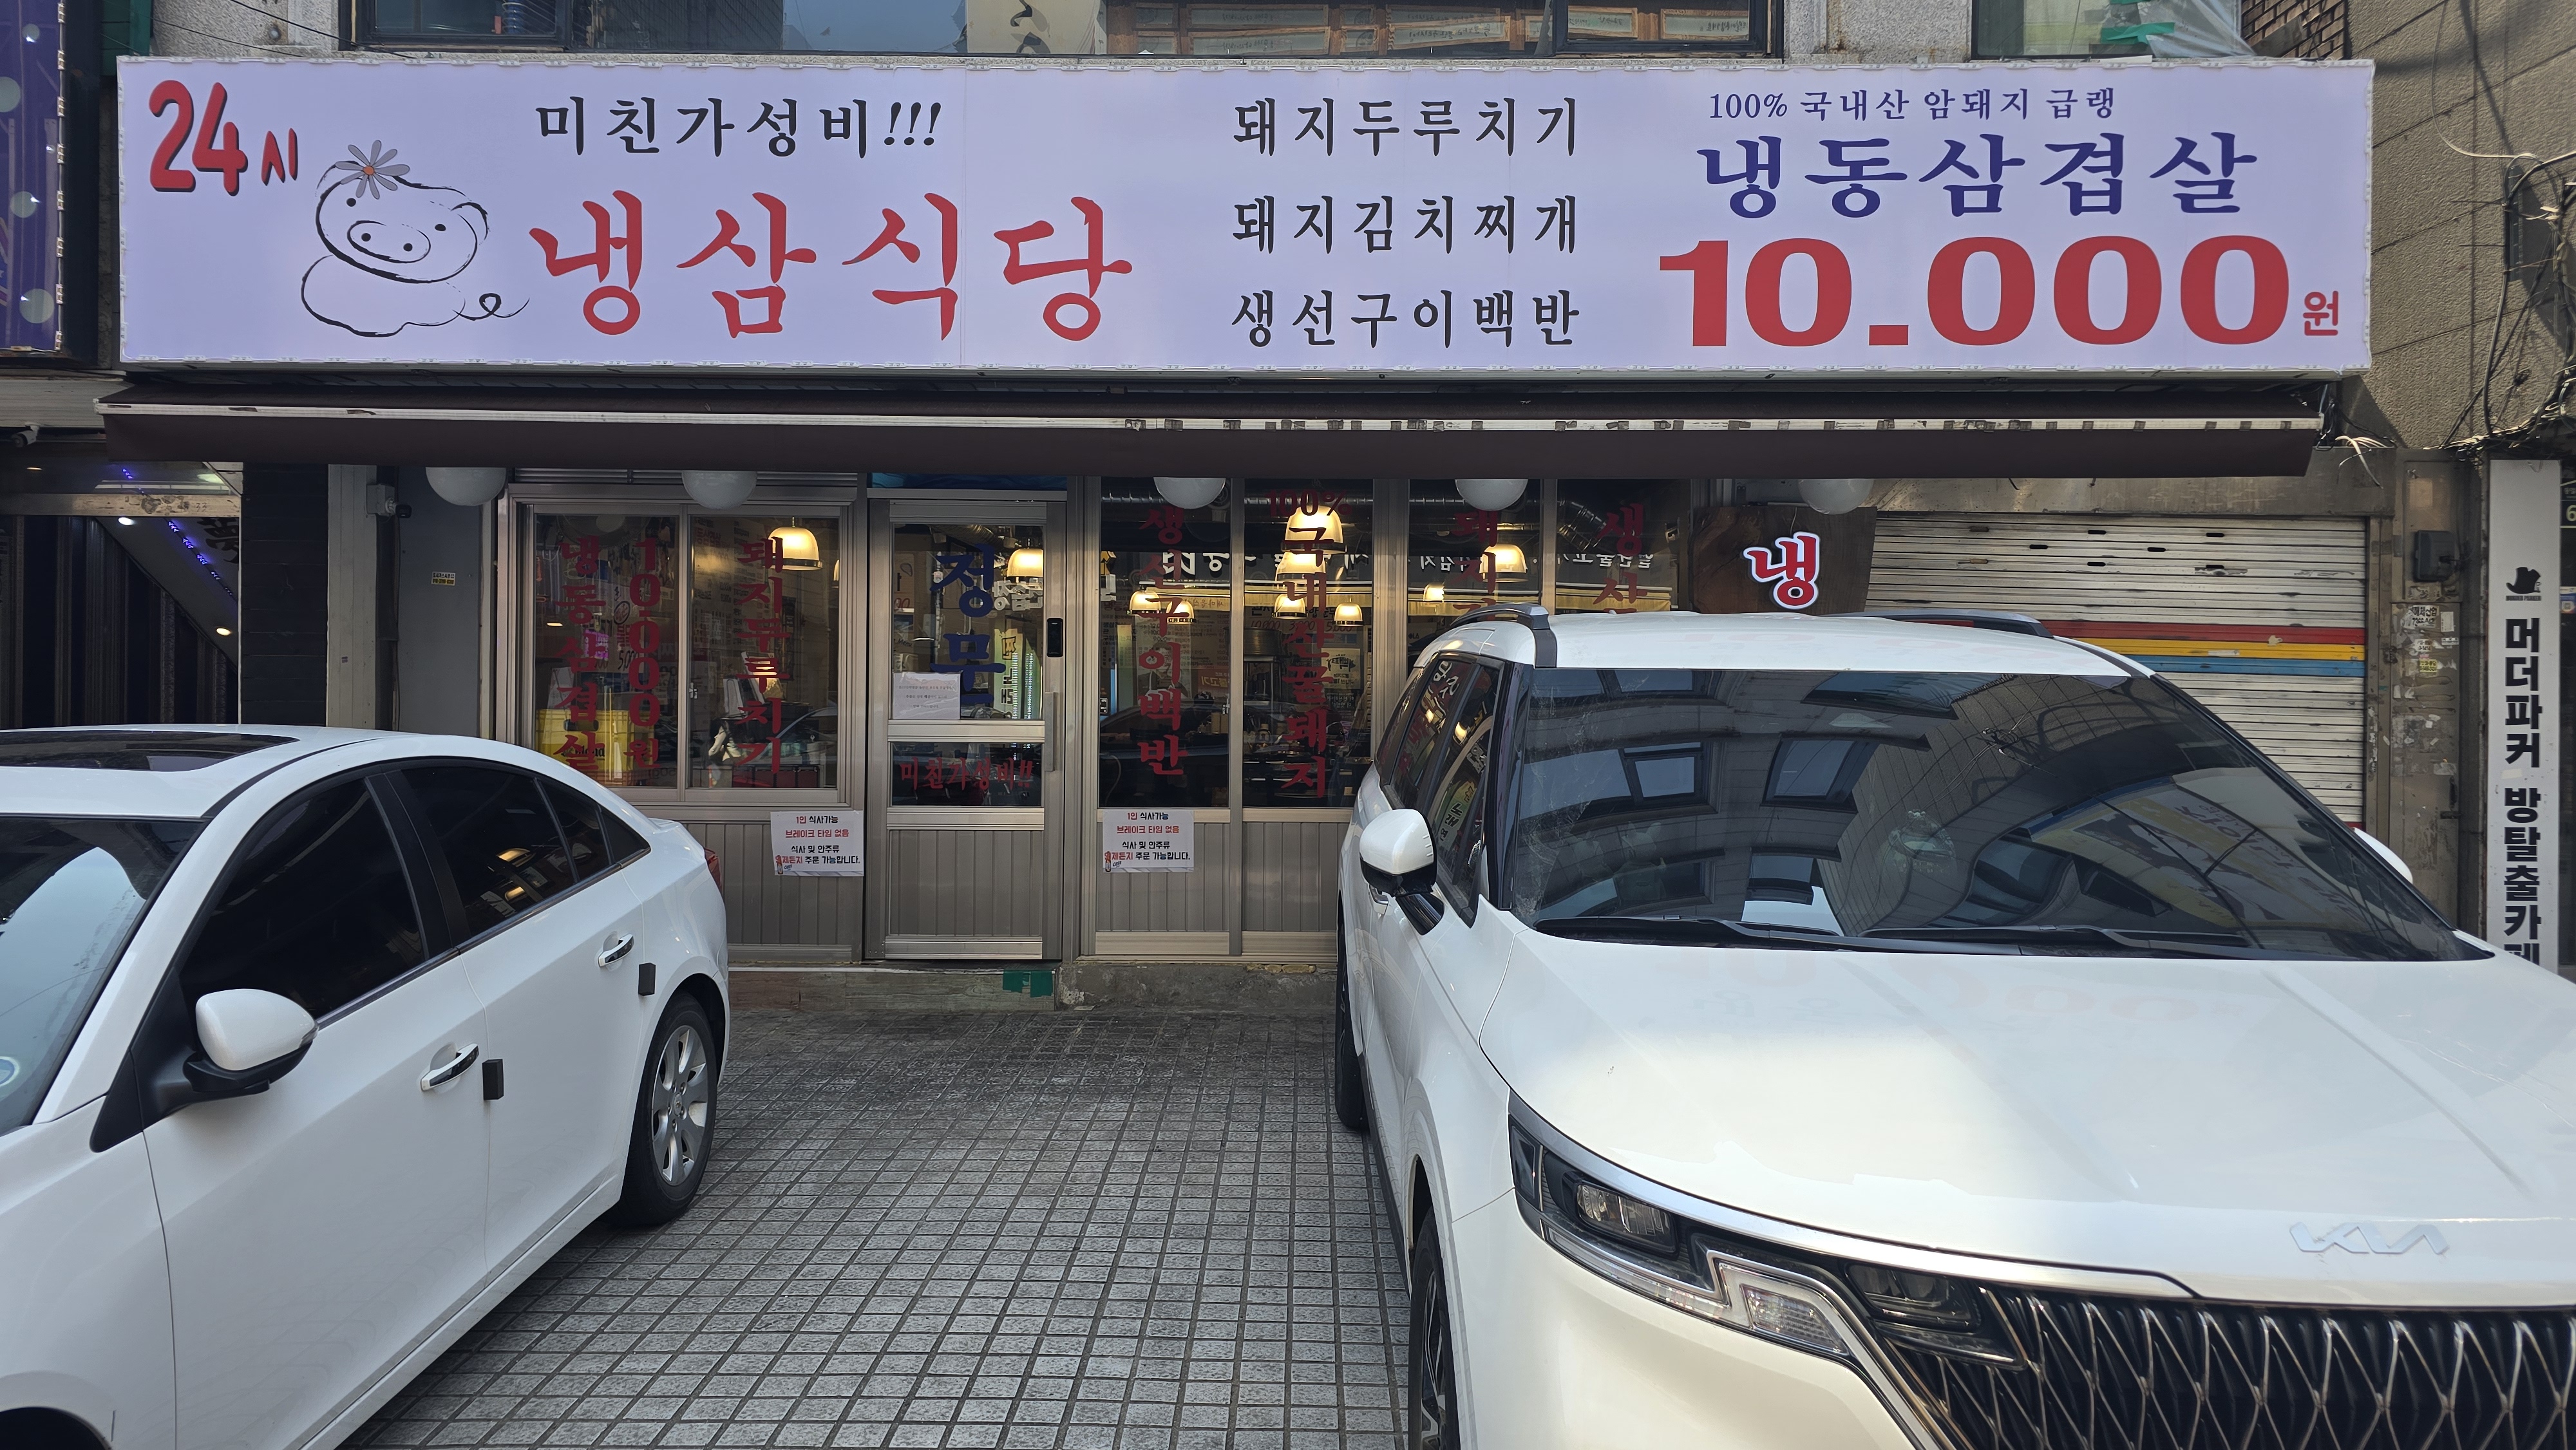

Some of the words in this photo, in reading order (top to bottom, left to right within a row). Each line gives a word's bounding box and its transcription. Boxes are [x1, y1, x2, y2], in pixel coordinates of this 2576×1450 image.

[536, 96, 942, 159] 미친가성비!!!
[1233, 97, 1576, 156] 돼지두루치기
[1709, 93, 1788, 119] 100%
[1800, 89, 1909, 122] 국내산
[1924, 88, 2029, 120] 암돼지
[2045, 87, 2115, 119] 급랭
[149, 80, 298, 196] 24시
[1697, 131, 2258, 219] 냉동삼겹살
[1233, 195, 1576, 254] 돼지김치찌개
[529, 190, 1132, 341] 냉삼식당
[1231, 289, 1580, 348] 생선구이백반
[1265, 489, 1353, 516] 100%
[1745, 533, 1818, 608] 냉
[553, 535, 607, 771] 냉동삼겹살
[930, 542, 1005, 705] 정문
[1137, 504, 1188, 777] 생선구이백반
[737, 535, 790, 774] 돼지두루치기
[1280, 524, 1335, 798] 국내산꿀돼지
[2505, 617, 2543, 768] 머더파커
[809, 815, 838, 824] 식사가능
[817, 829, 831, 838] 타임
[835, 829, 849, 838] 없음
[1117, 825, 1146, 834] 브레이크
[805, 856, 819, 864] 주문
[822, 856, 860, 864] 가능합니다.
[1135, 852, 1150, 860] 주문
[1152, 852, 1191, 860] 가능합니다.
[2289, 1221, 2450, 1255] KIA
